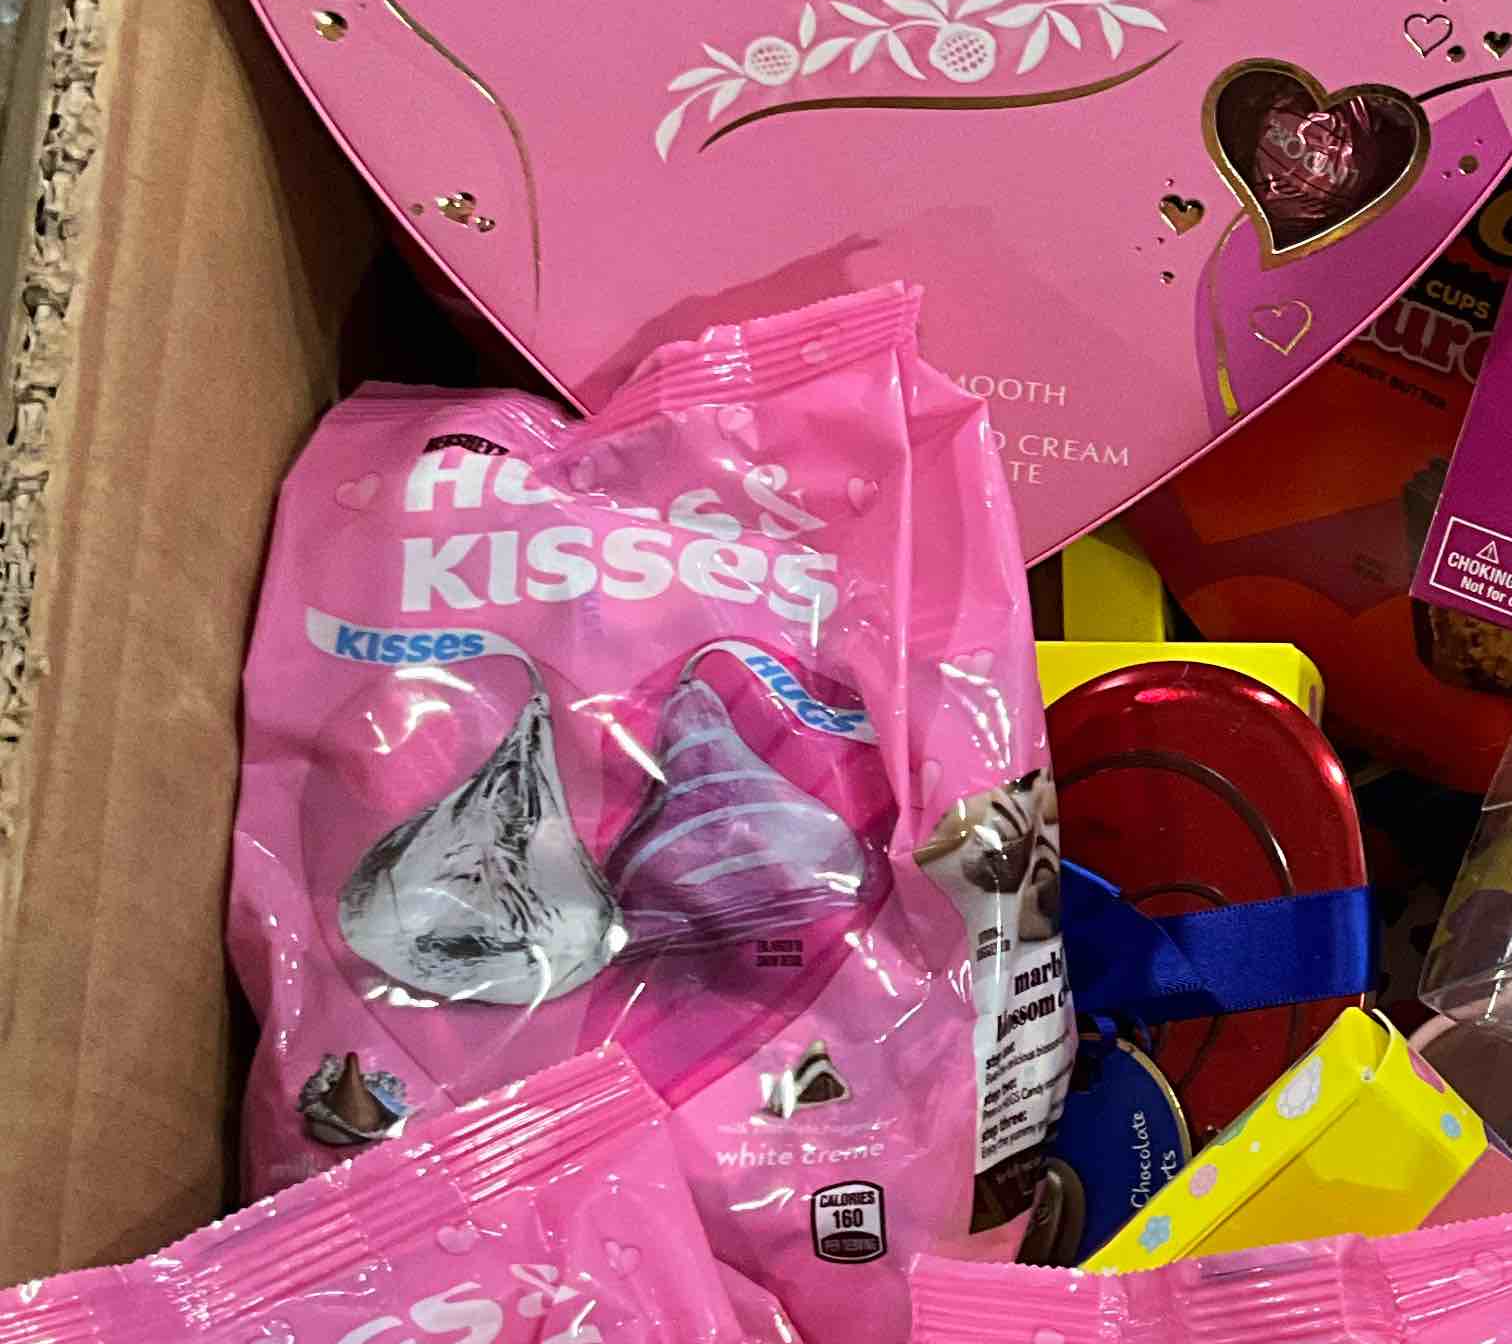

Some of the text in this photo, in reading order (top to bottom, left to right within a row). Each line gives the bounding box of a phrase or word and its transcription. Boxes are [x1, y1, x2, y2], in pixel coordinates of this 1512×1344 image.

[1426, 279, 1491, 320] CUPS
[954, 374, 1067, 406] OOTH
[1018, 434, 1130, 467] CREAM
[1460, 575, 1485, 597] Not
[1487, 585, 1506, 603] for
[743, 653, 866, 736] HUGS
[716, 1142, 793, 1168] white
[1131, 1110, 1152, 1208] Chocolate
[820, 1191, 875, 1208] CALORIES
[832, 1208, 863, 1229] 160
